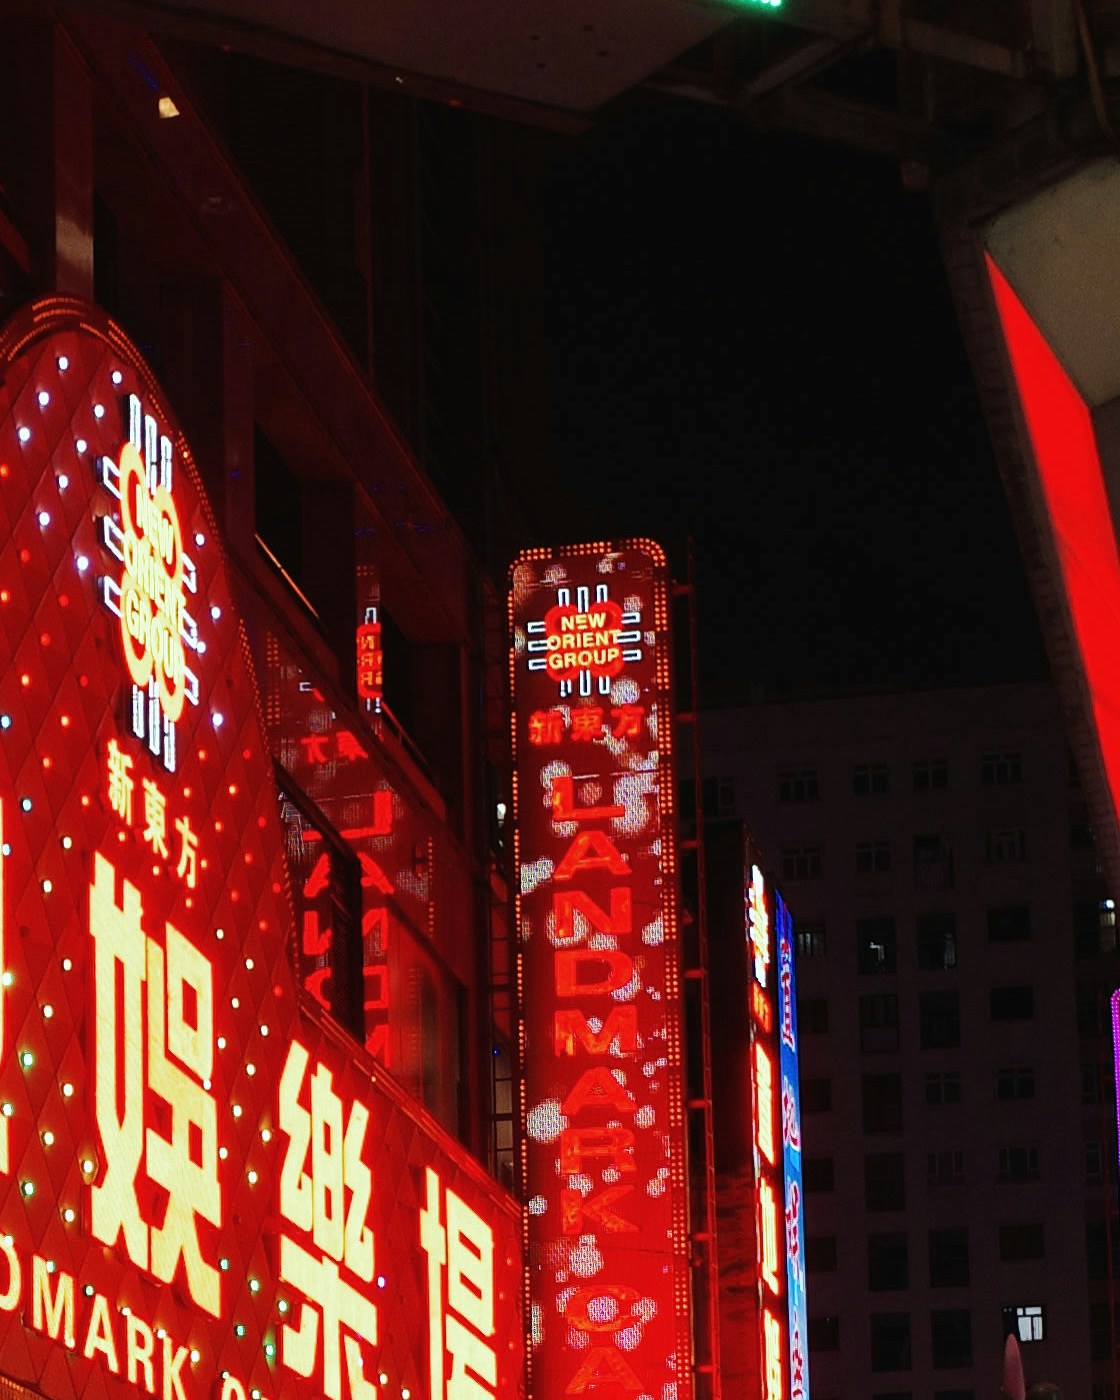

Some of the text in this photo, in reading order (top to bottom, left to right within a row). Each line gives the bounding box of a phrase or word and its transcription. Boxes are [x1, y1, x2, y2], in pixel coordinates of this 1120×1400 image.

[135, 483, 174, 565] NEW
[123, 528, 186, 632] ORIENT
[125, 588, 185, 686] GROUP
[546, 629, 622, 651] ORIENT
[548, 647, 620, 670] GROUP
[561, 612, 607, 632] NEW
[528, 704, 645, 746] 新東方
[106, 739, 200, 888] 新東方
[552, 775, 643, 1236] LANDMARK
